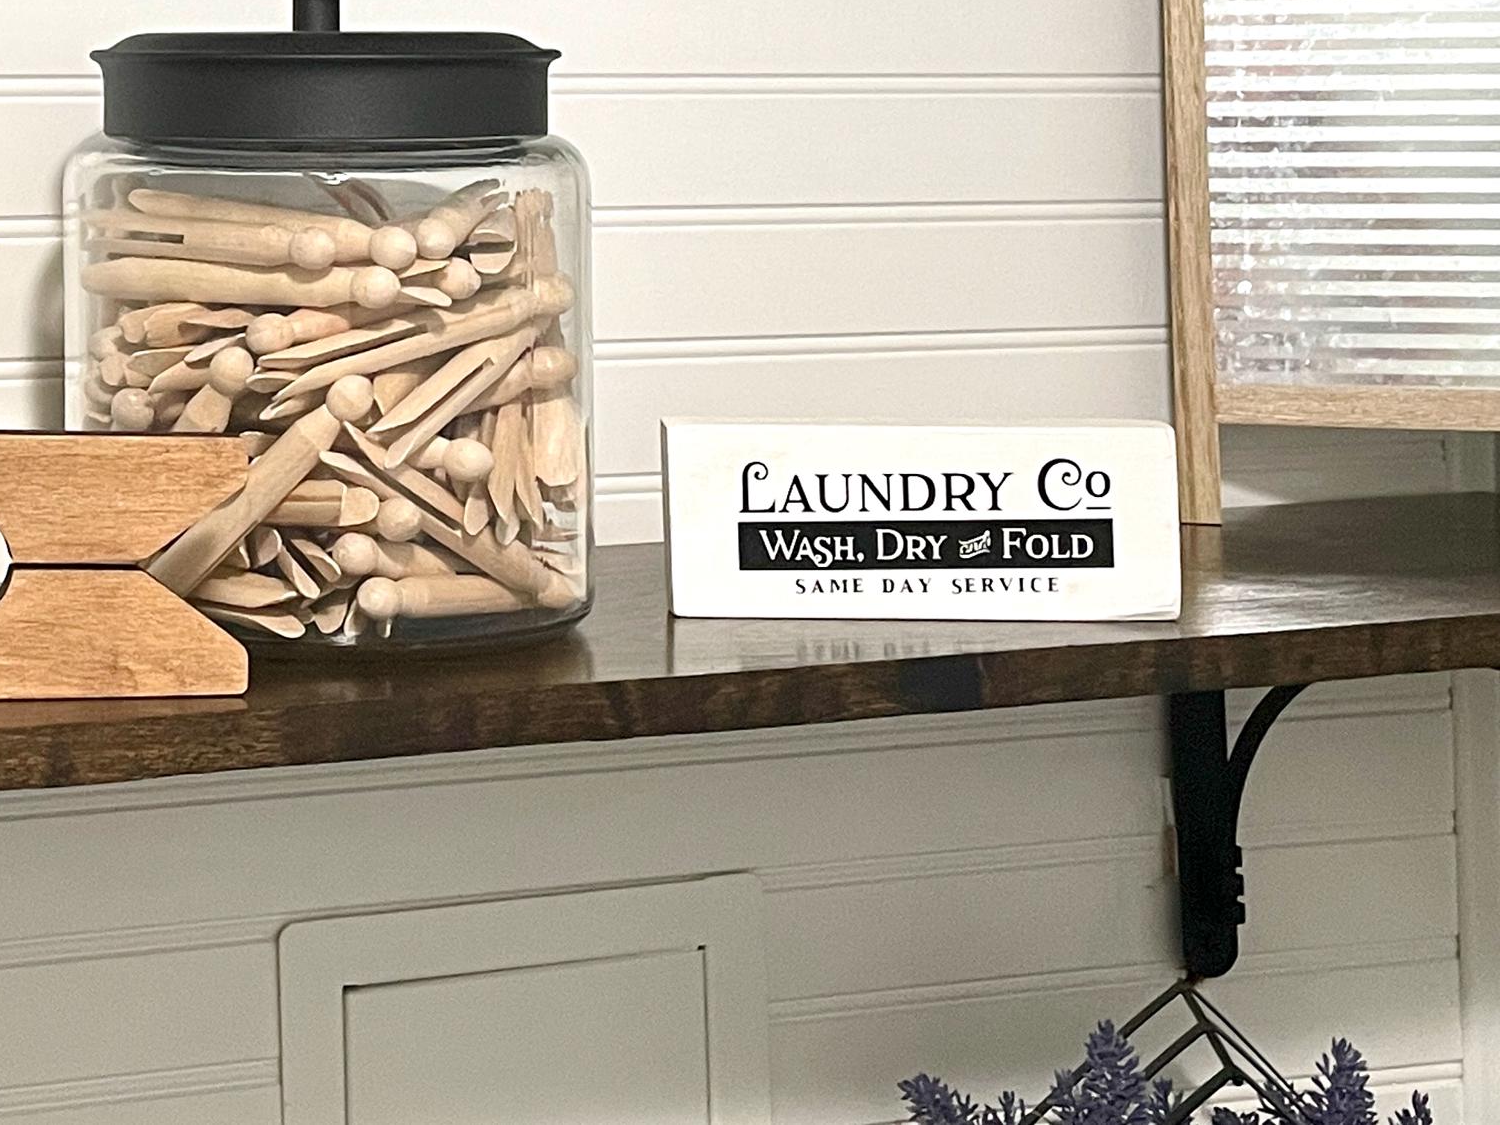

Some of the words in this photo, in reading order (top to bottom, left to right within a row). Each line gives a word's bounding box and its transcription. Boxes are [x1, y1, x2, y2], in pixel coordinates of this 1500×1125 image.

[739, 461, 1013, 513] LAUNDRY
[759, 529, 865, 568] WASH,
[875, 528, 948, 561] DRY
[1001, 527, 1094, 560] FOLD
[795, 578, 864, 594] SAME
[882, 578, 932, 594] DAY
[951, 576, 1060, 594] SERVICE
